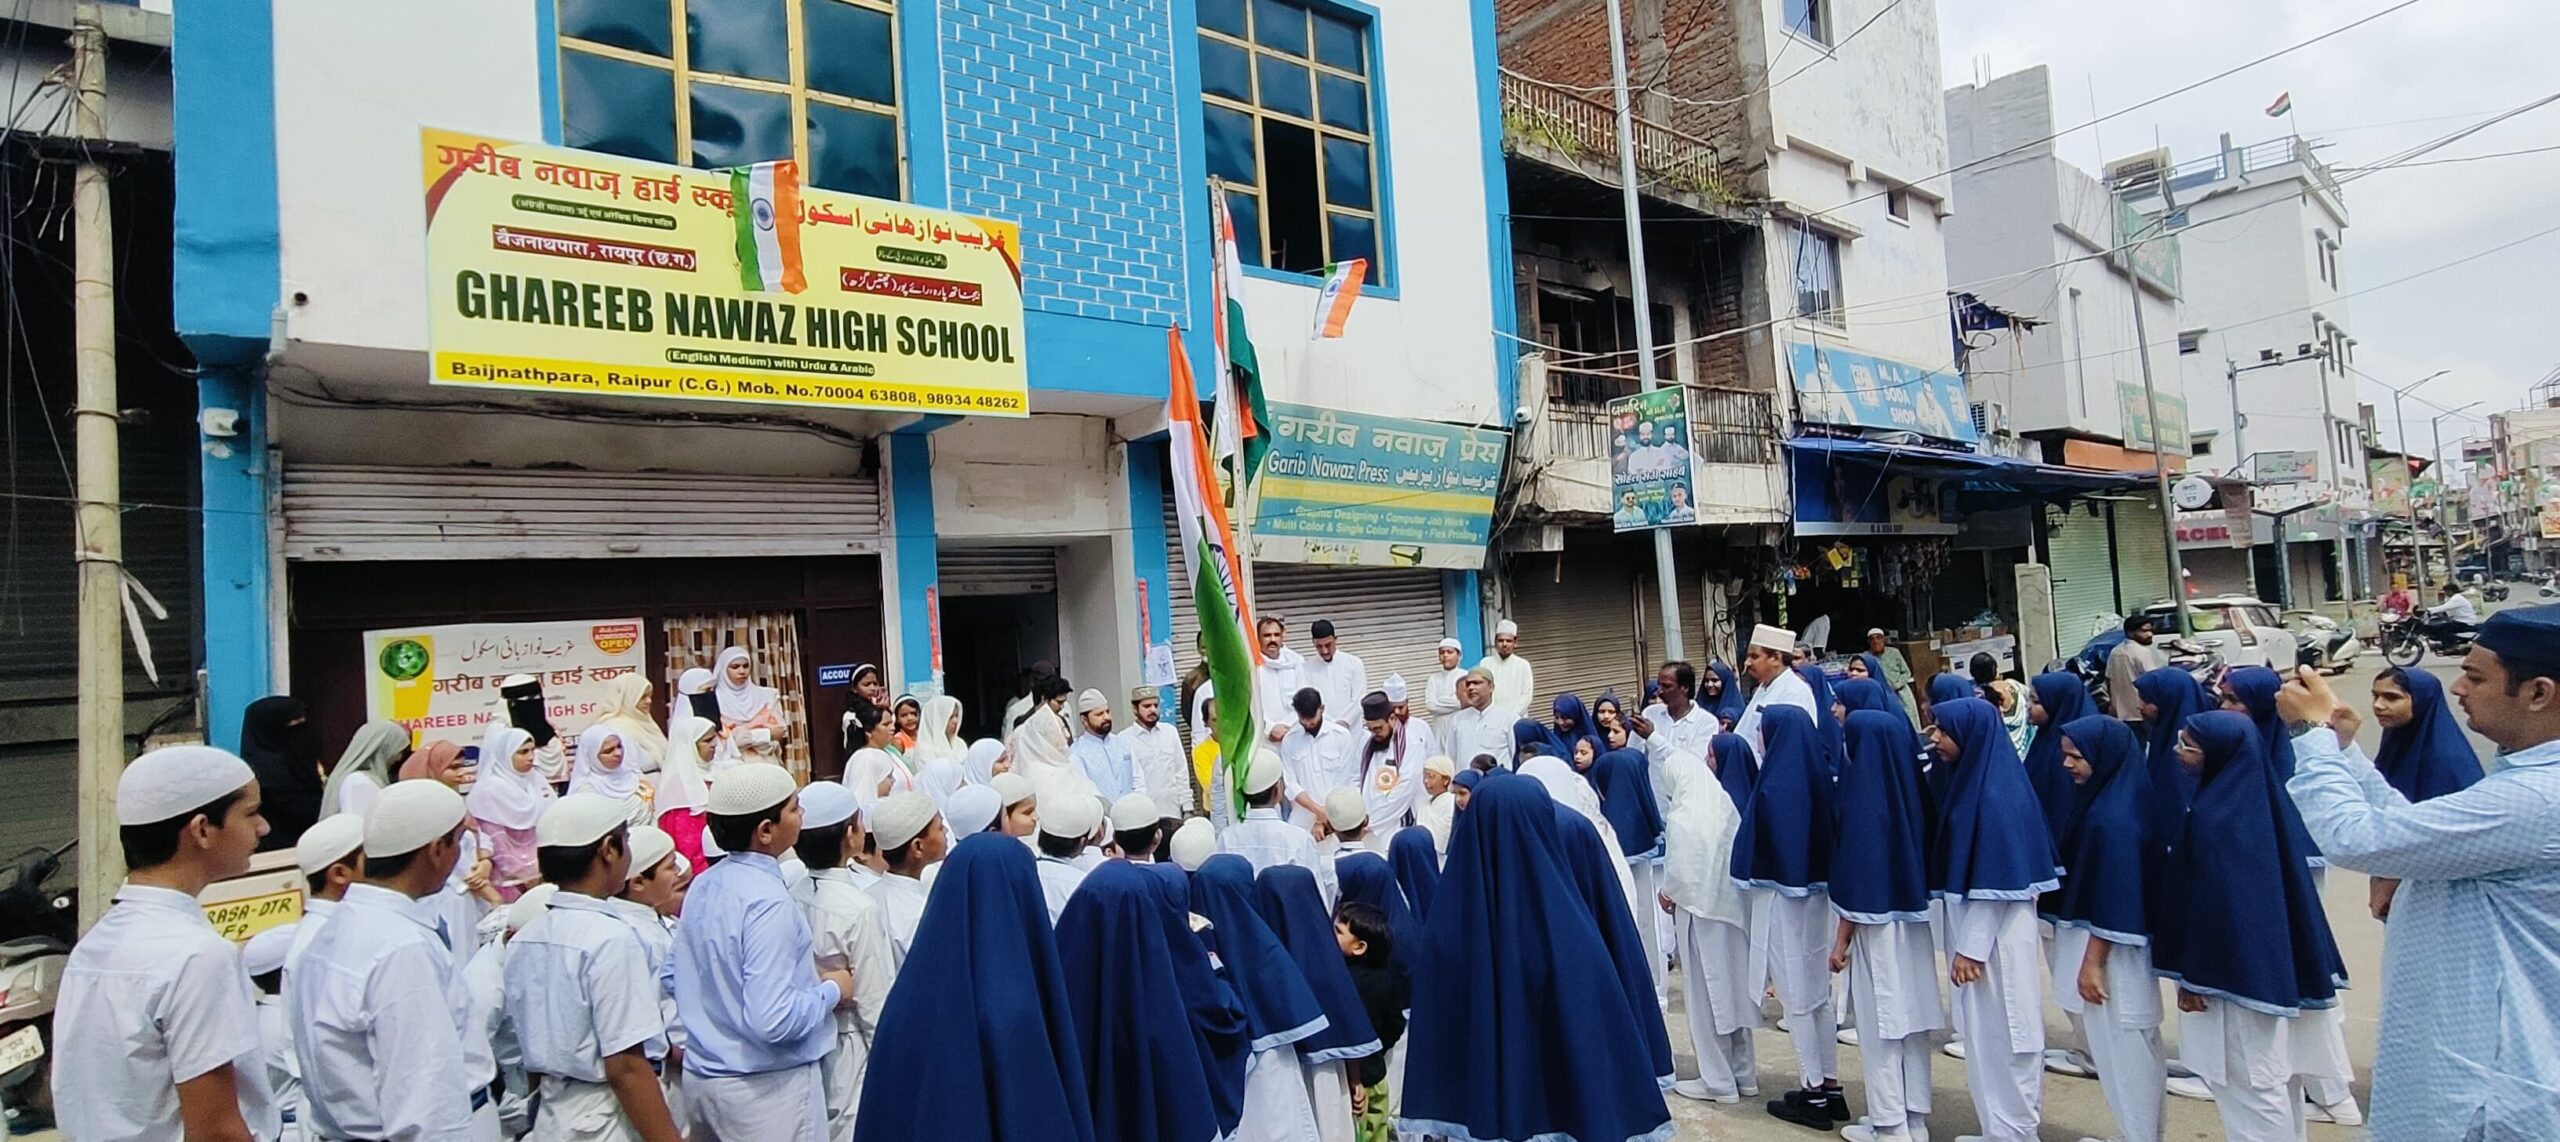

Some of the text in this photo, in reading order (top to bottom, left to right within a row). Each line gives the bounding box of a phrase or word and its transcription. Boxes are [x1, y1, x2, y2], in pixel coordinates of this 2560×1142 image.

[436, 143, 522, 179] गरीब
[598, 244, 646, 267] रायपुर
[456, 269, 1015, 364] GHAREEB NAWAZ HIGH SCHOOL
[667, 349, 874, 375] (English Medium) with Urdu & Arabic
[452, 362, 600, 387] Baijnathpara,
[608, 372, 673, 390] Raipur
[679, 376, 731, 394] (C.G.)
[738, 381, 780, 396] Mob.
[869, 389, 922, 405] 63808,
[927, 393, 971, 406] 98934
[977, 396, 1019, 409] 48262
[1883, 387, 1912, 406] SODA
[1890, 407, 1917, 425] SHOP
[1277, 411, 1501, 464] गरीब नवाज़ प्रेस
[1268, 451, 1389, 483] Garib Nawaz Press
[1272, 519, 1297, 531] Multi
[1299, 521, 1325, 532] Color
[1327, 523, 1333, 532] &
[1336, 523, 1364, 535] Single
[1366, 525, 1389, 536] Color
[1335, 509, 1379, 523] Designing
[1386, 512, 1425, 526] Computer
[600, 638, 632, 649] OPEN
[433, 673, 484, 695] गरीब
[551, 666, 584, 686] हाई
[822, 669, 851, 680] ACCOU
[400, 714, 467, 730] HAREEB
